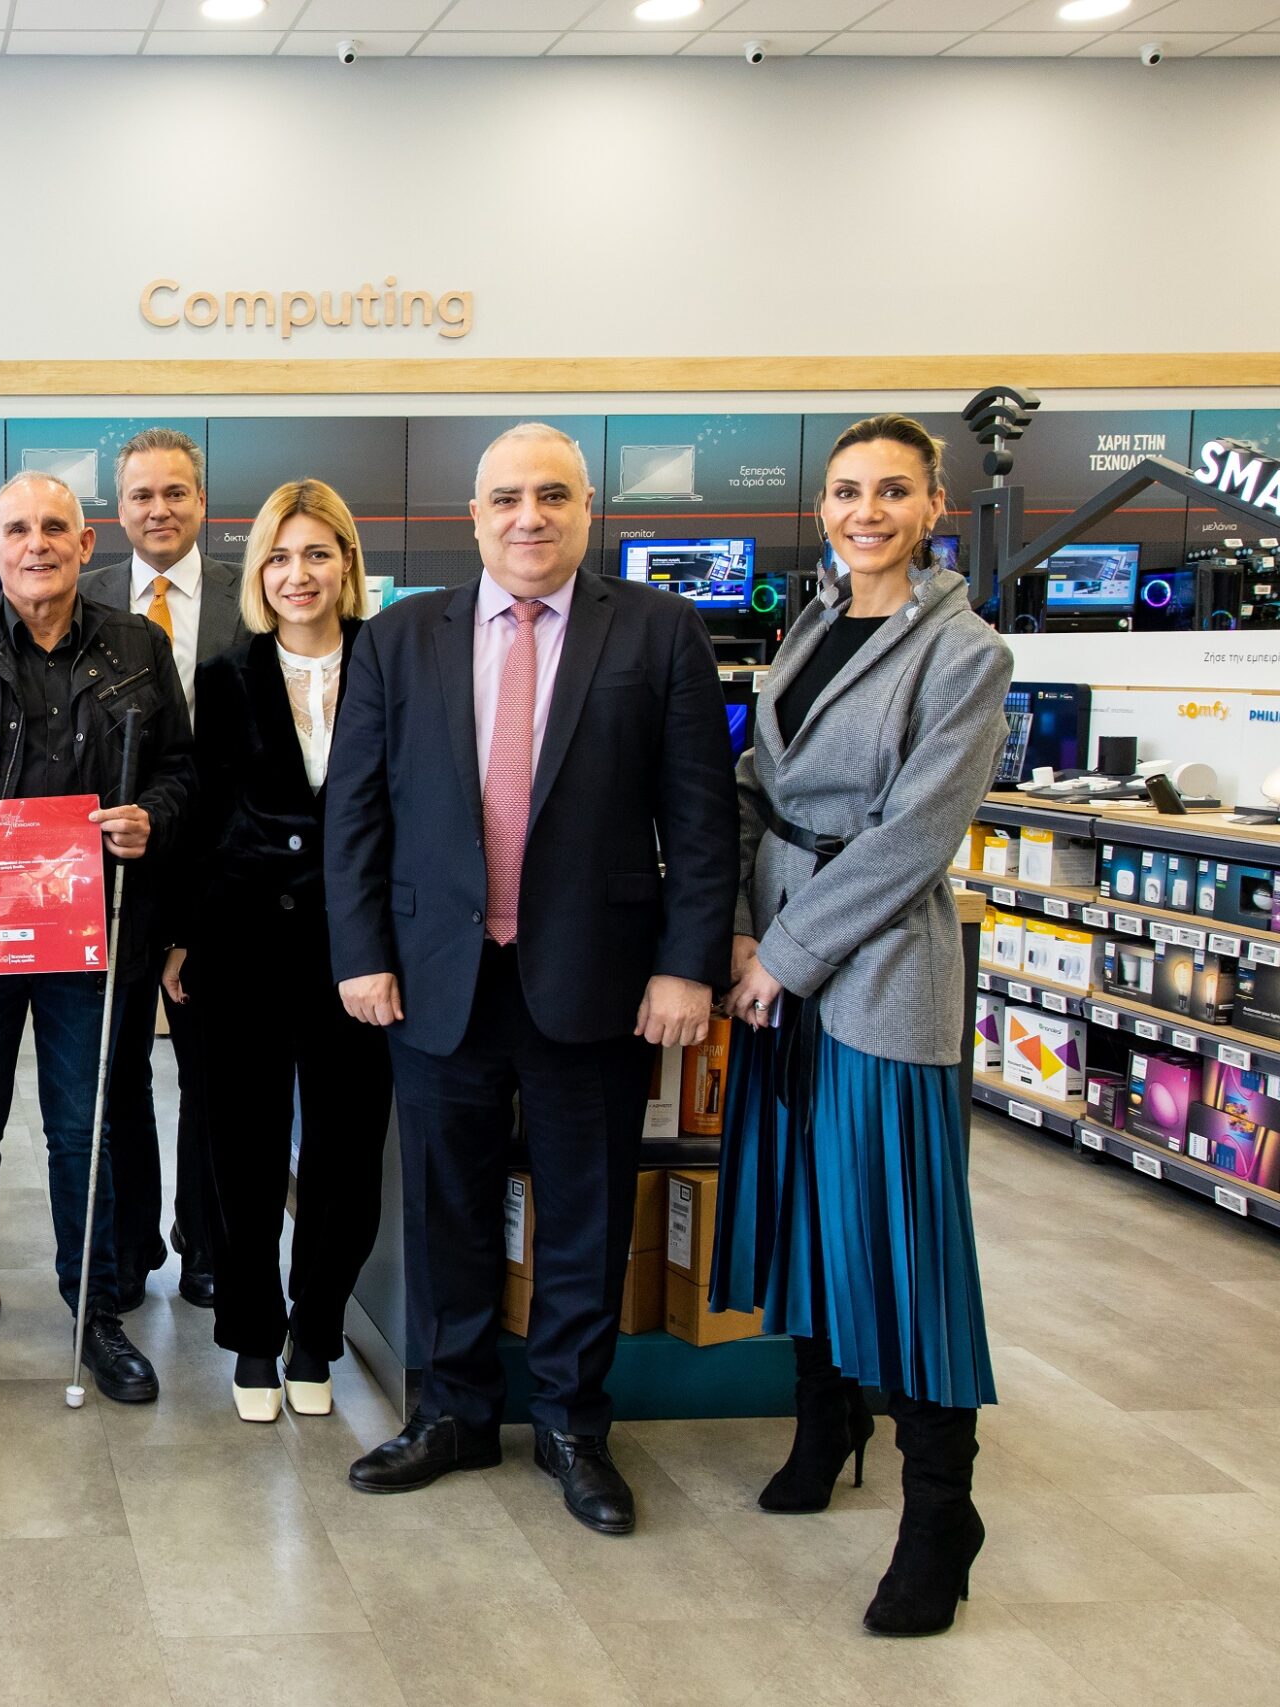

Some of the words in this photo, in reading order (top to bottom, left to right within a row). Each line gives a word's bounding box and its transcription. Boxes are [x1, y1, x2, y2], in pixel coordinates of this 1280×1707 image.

[139, 275, 473, 338] Computing
[1097, 435, 1130, 451] ΧΑΡΗ
[1133, 435, 1166, 450] ΣΤΗΝ
[739, 465, 786, 477] ξεπερνάς
[728, 479, 739, 487] τα
[742, 476, 764, 489] όριά
[766, 478, 786, 487] σου
[1202, 522, 1238, 532] μελάνια
[223, 532, 250, 542] δικτυ
[620, 529, 656, 539] monitor
[1204, 652, 1226, 664] Ζήσε
[1229, 654, 1243, 664] την
[1178, 700, 1228, 721] somfy
[1249, 710, 1280, 722] PHILI
[84, 945, 99, 962] K
[699, 1044, 725, 1057] SPRAY
